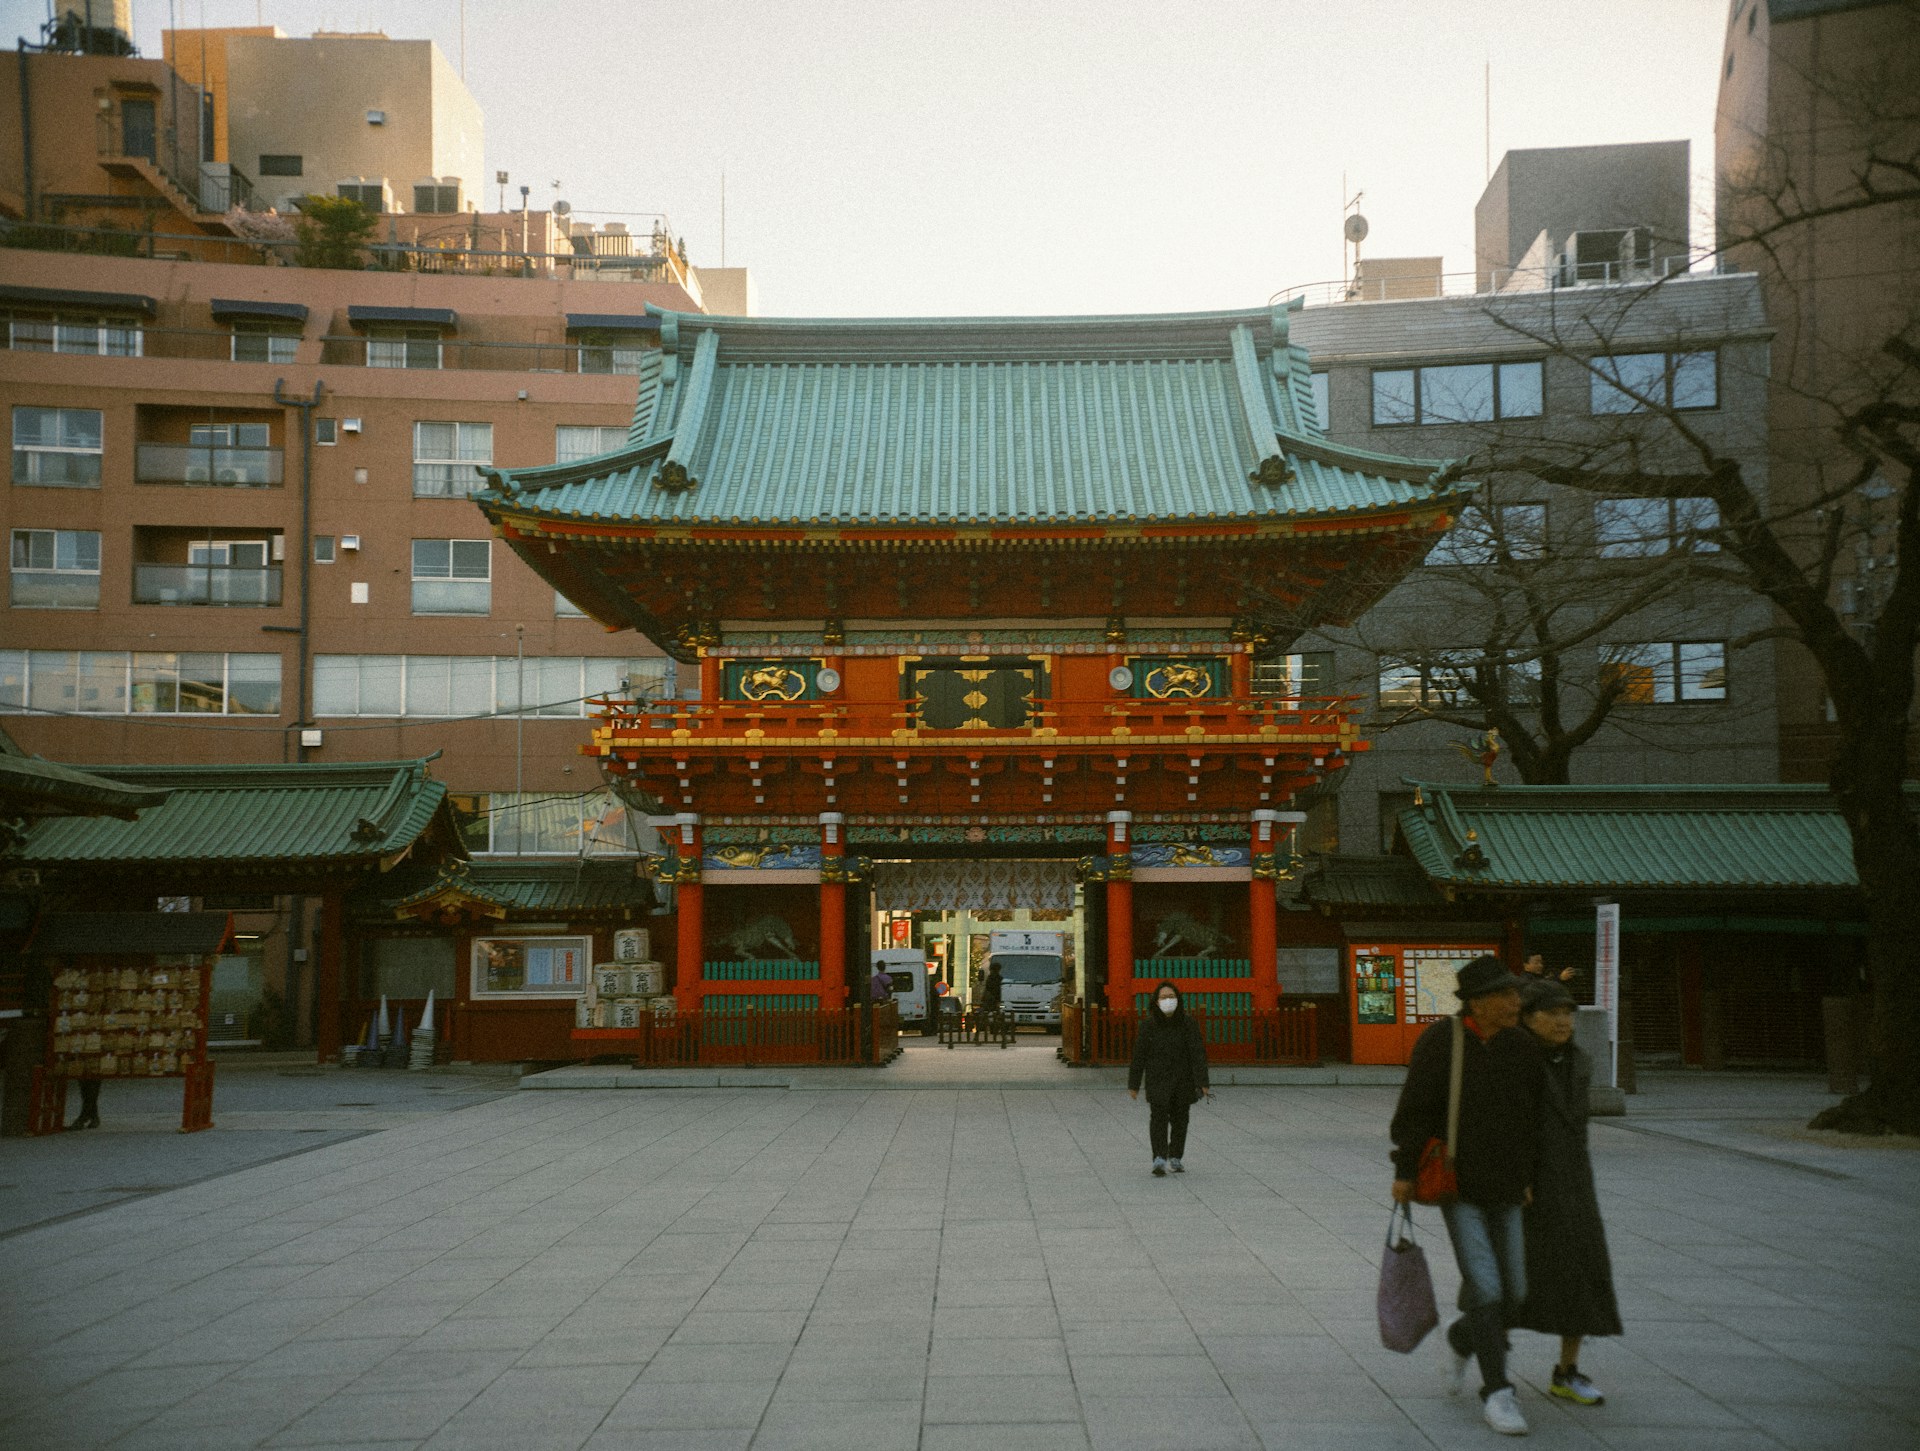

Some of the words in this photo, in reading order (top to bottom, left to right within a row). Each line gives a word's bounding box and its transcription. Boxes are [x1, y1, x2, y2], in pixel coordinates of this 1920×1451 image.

[622, 937, 637, 959] 金婚
[603, 971, 617, 993] 金婚
[635, 971, 650, 993] 金婚
[620, 1006, 634, 1027] 金婚
